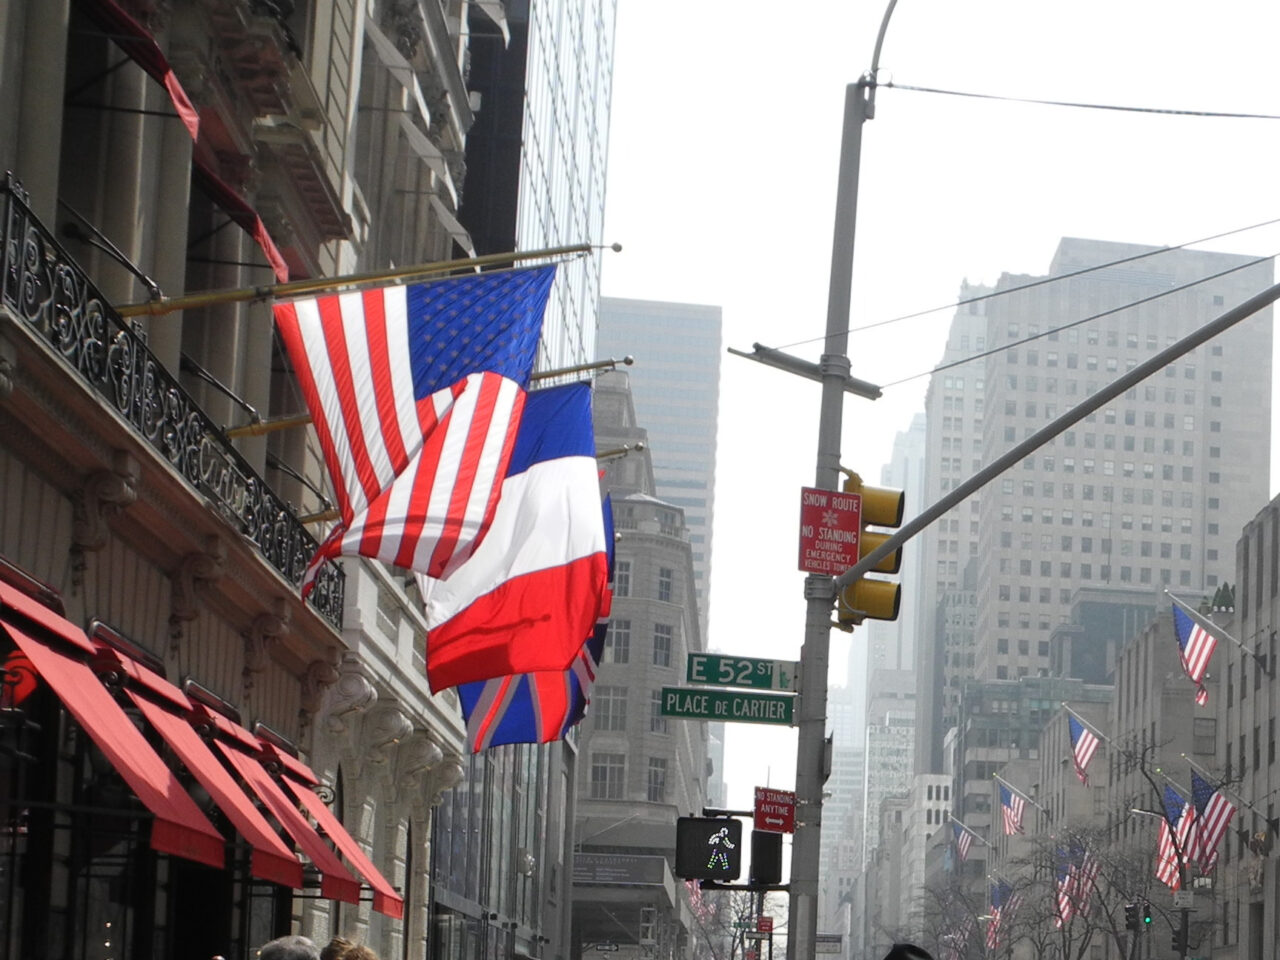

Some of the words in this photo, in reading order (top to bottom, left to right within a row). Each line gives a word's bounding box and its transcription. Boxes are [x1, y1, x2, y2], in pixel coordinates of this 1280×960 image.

[803, 493, 828, 507] SNOW
[832, 497, 858, 512] ROUTE
[802, 525, 814, 538] NO
[818, 527, 857, 544] STANDING
[815, 540, 842, 552] DURING
[806, 549, 851, 562] EMERGENCY
[691, 656, 707, 681] E
[718, 659, 753, 684] 52
[757, 662, 774, 675] ST
[667, 693, 709, 714] PLACE
[715, 700, 729, 715] DE
[733, 698, 786, 719] CARTIER
[757, 790, 765, 800] NO
[767, 792, 793, 804] STANDING
[761, 803, 789, 816] ANYTIME
